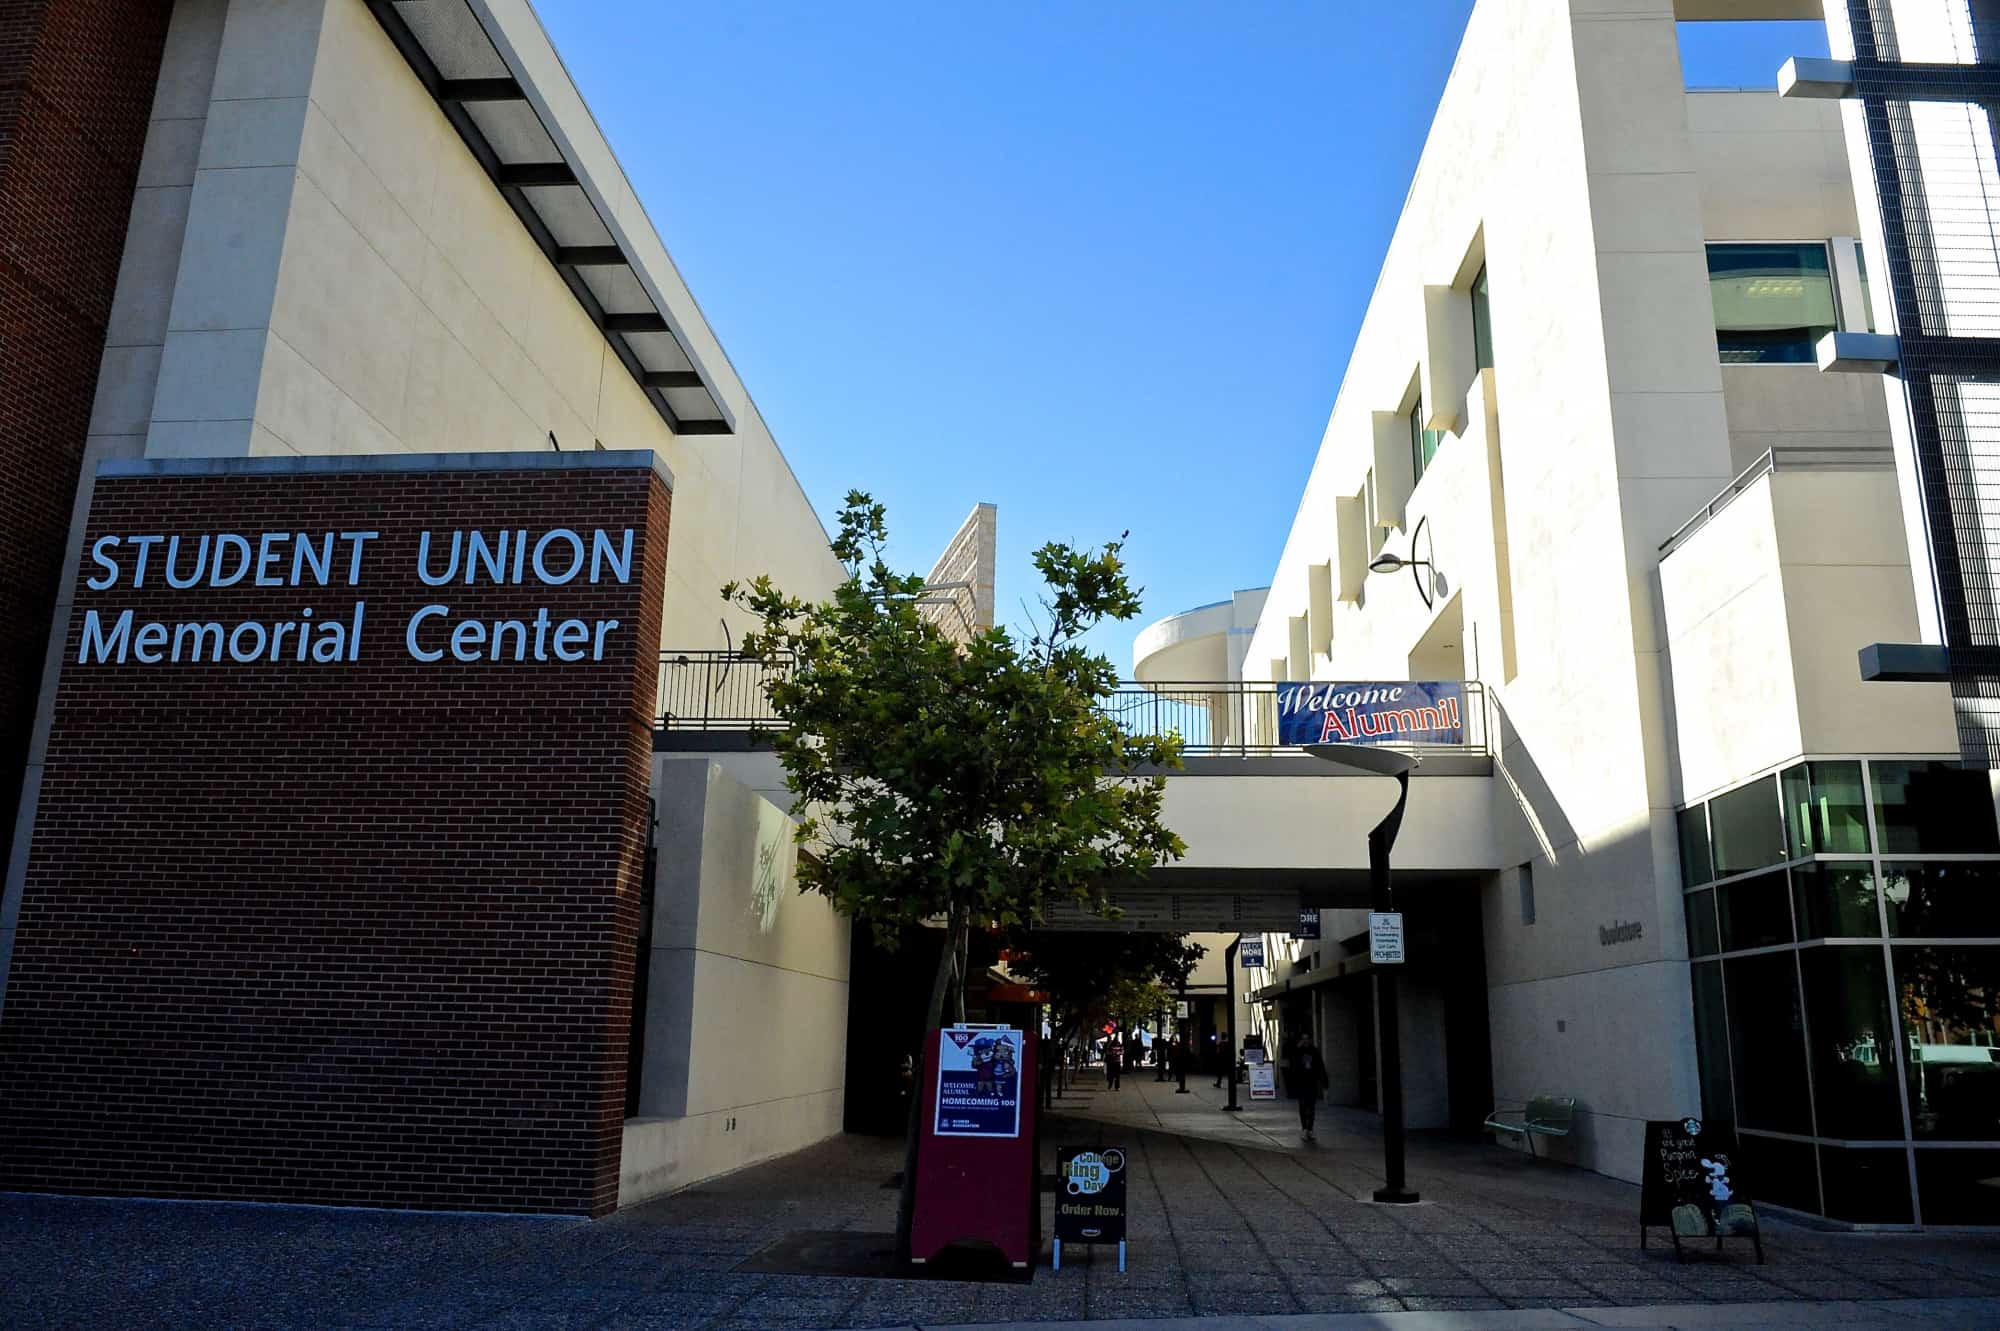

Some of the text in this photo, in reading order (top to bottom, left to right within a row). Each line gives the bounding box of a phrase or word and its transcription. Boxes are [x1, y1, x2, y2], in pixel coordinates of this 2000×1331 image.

[87, 528, 634, 591] STUDENT UNION
[77, 601, 619, 665] Memorial Center
[1277, 683, 1403, 716] Welcome
[1318, 697, 1461, 743] Alumni!
[942, 1098, 999, 1106] HOMECOMING
[1079, 1153, 1119, 1166] College
[1062, 1161, 1100, 1180] Ring
[1084, 1181, 1104, 1192] Day
[1061, 1204, 1119, 1216] Order Now
